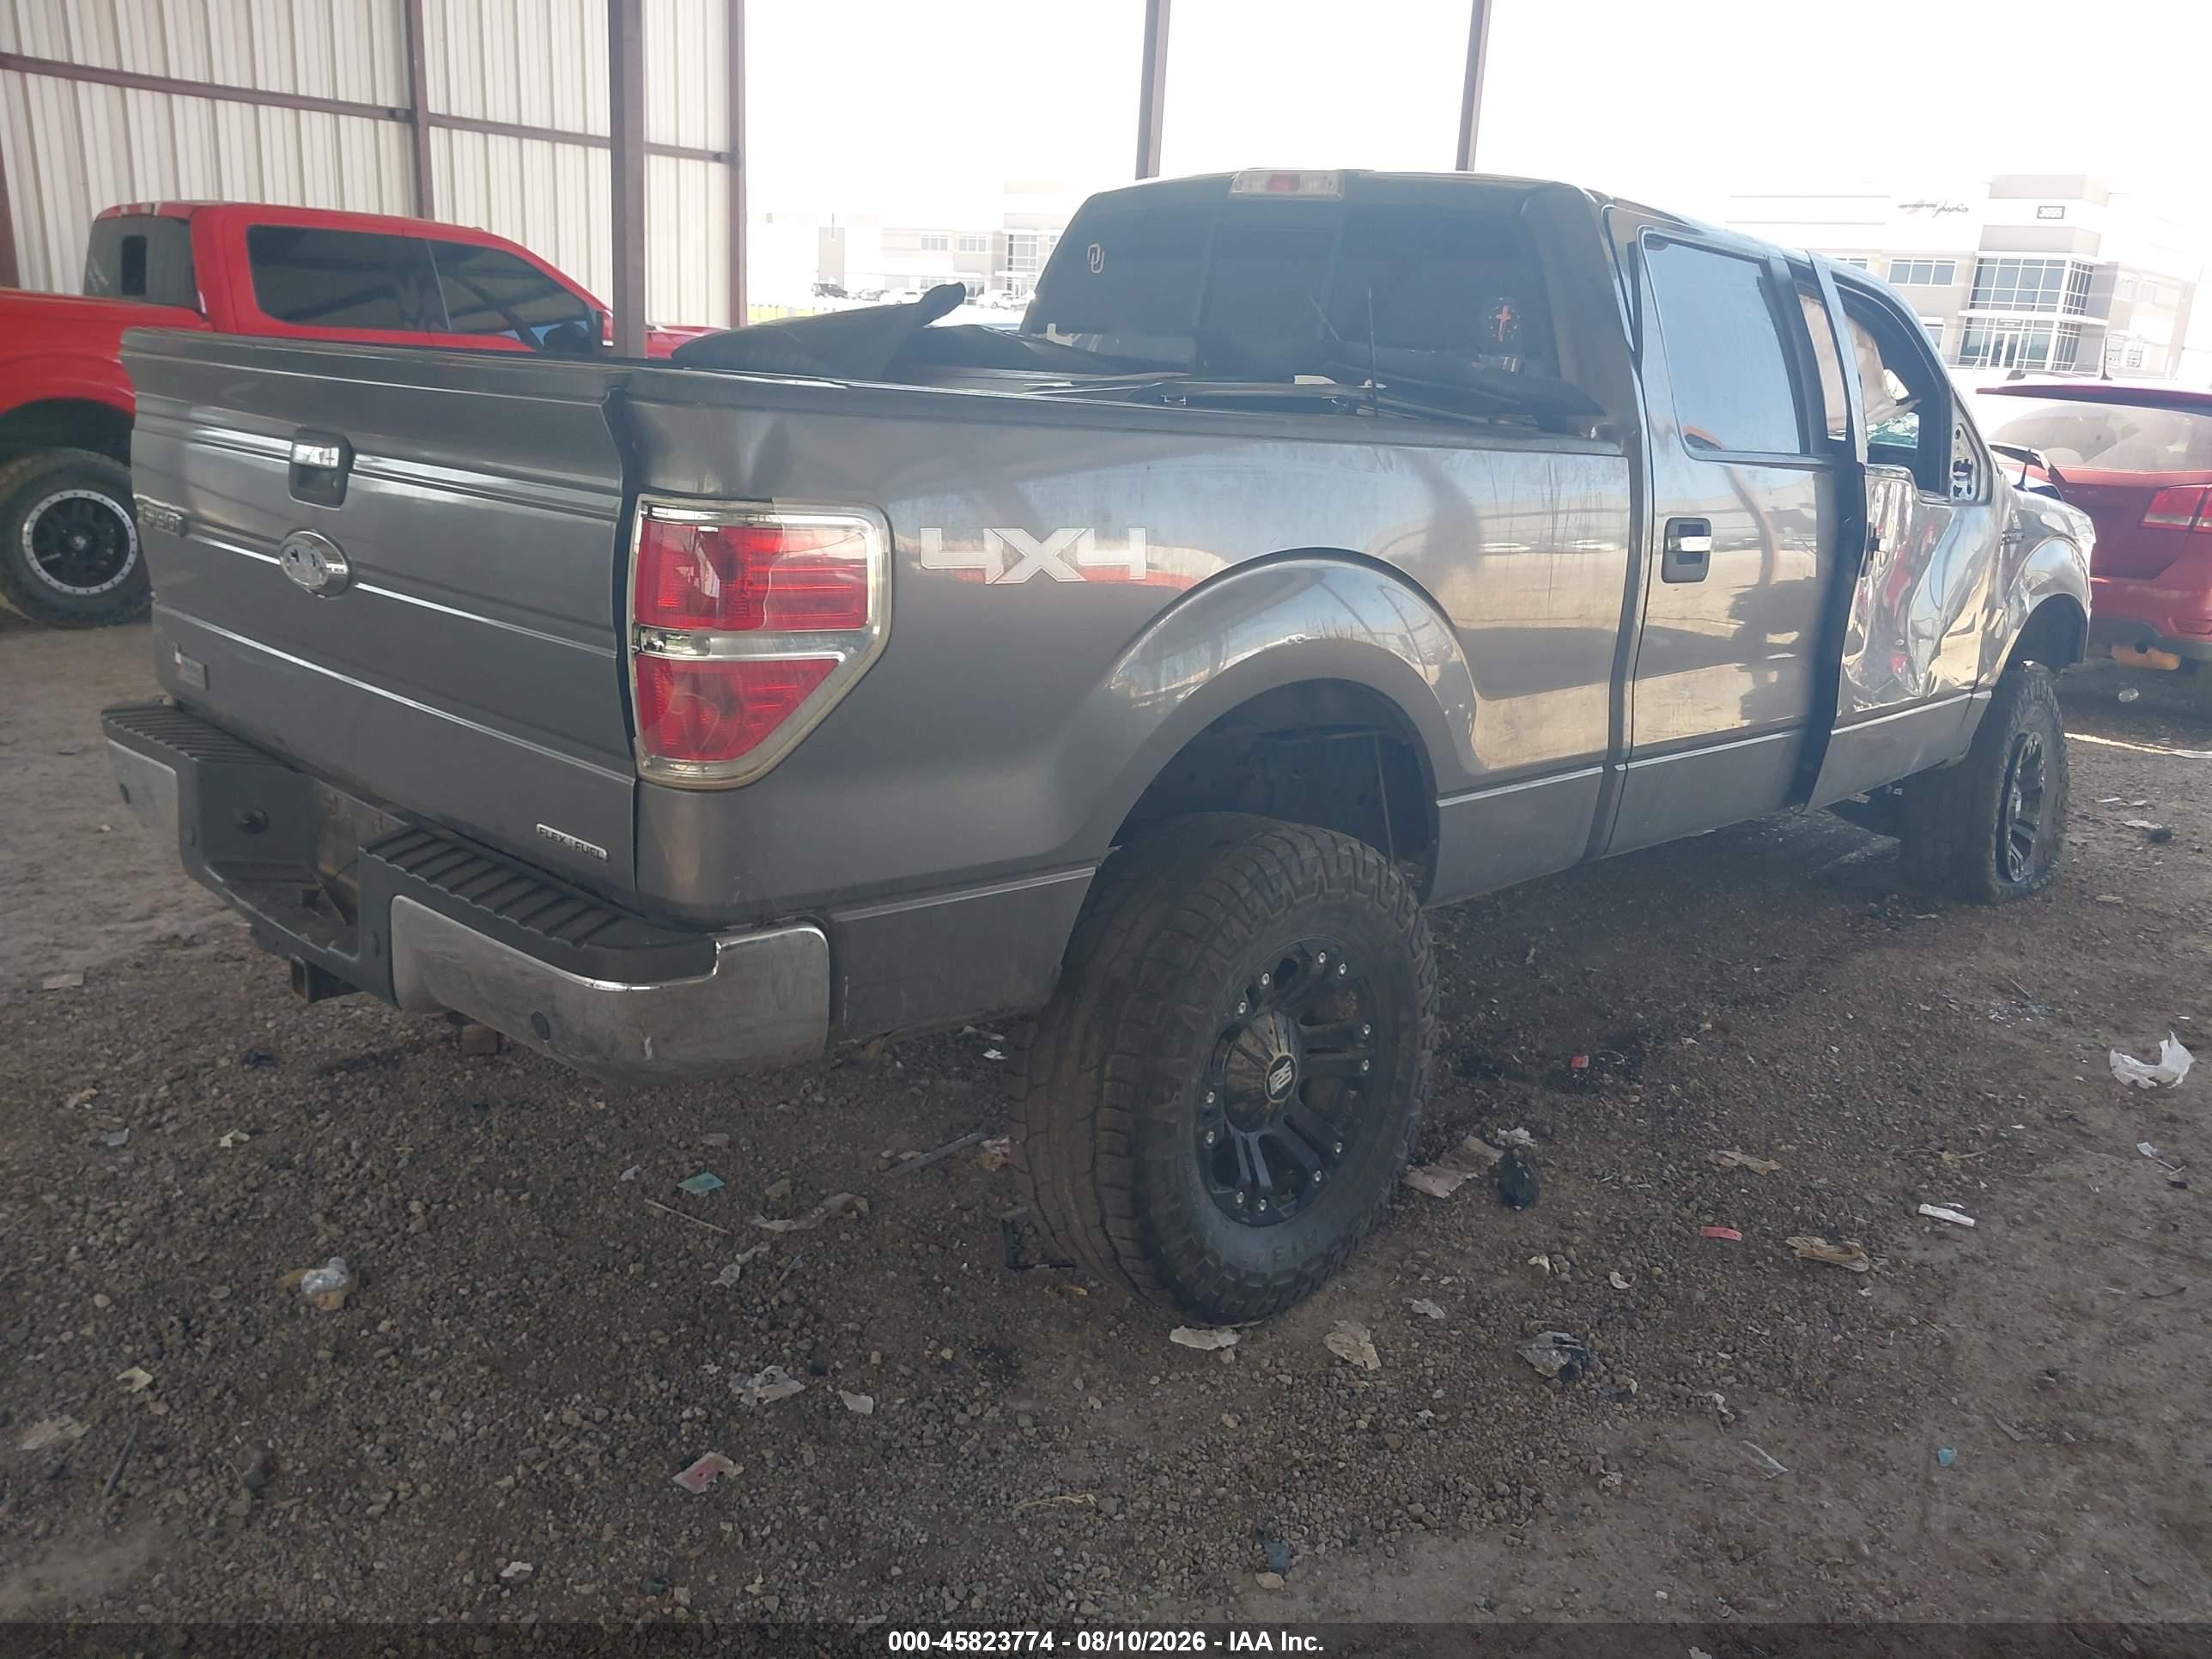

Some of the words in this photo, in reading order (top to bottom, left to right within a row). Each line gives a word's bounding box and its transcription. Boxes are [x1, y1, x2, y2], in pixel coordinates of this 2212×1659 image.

[920, 527, 1147, 585] 4X4
[538, 827, 566, 845] FLEX
[574, 842, 605, 860] FUEL
